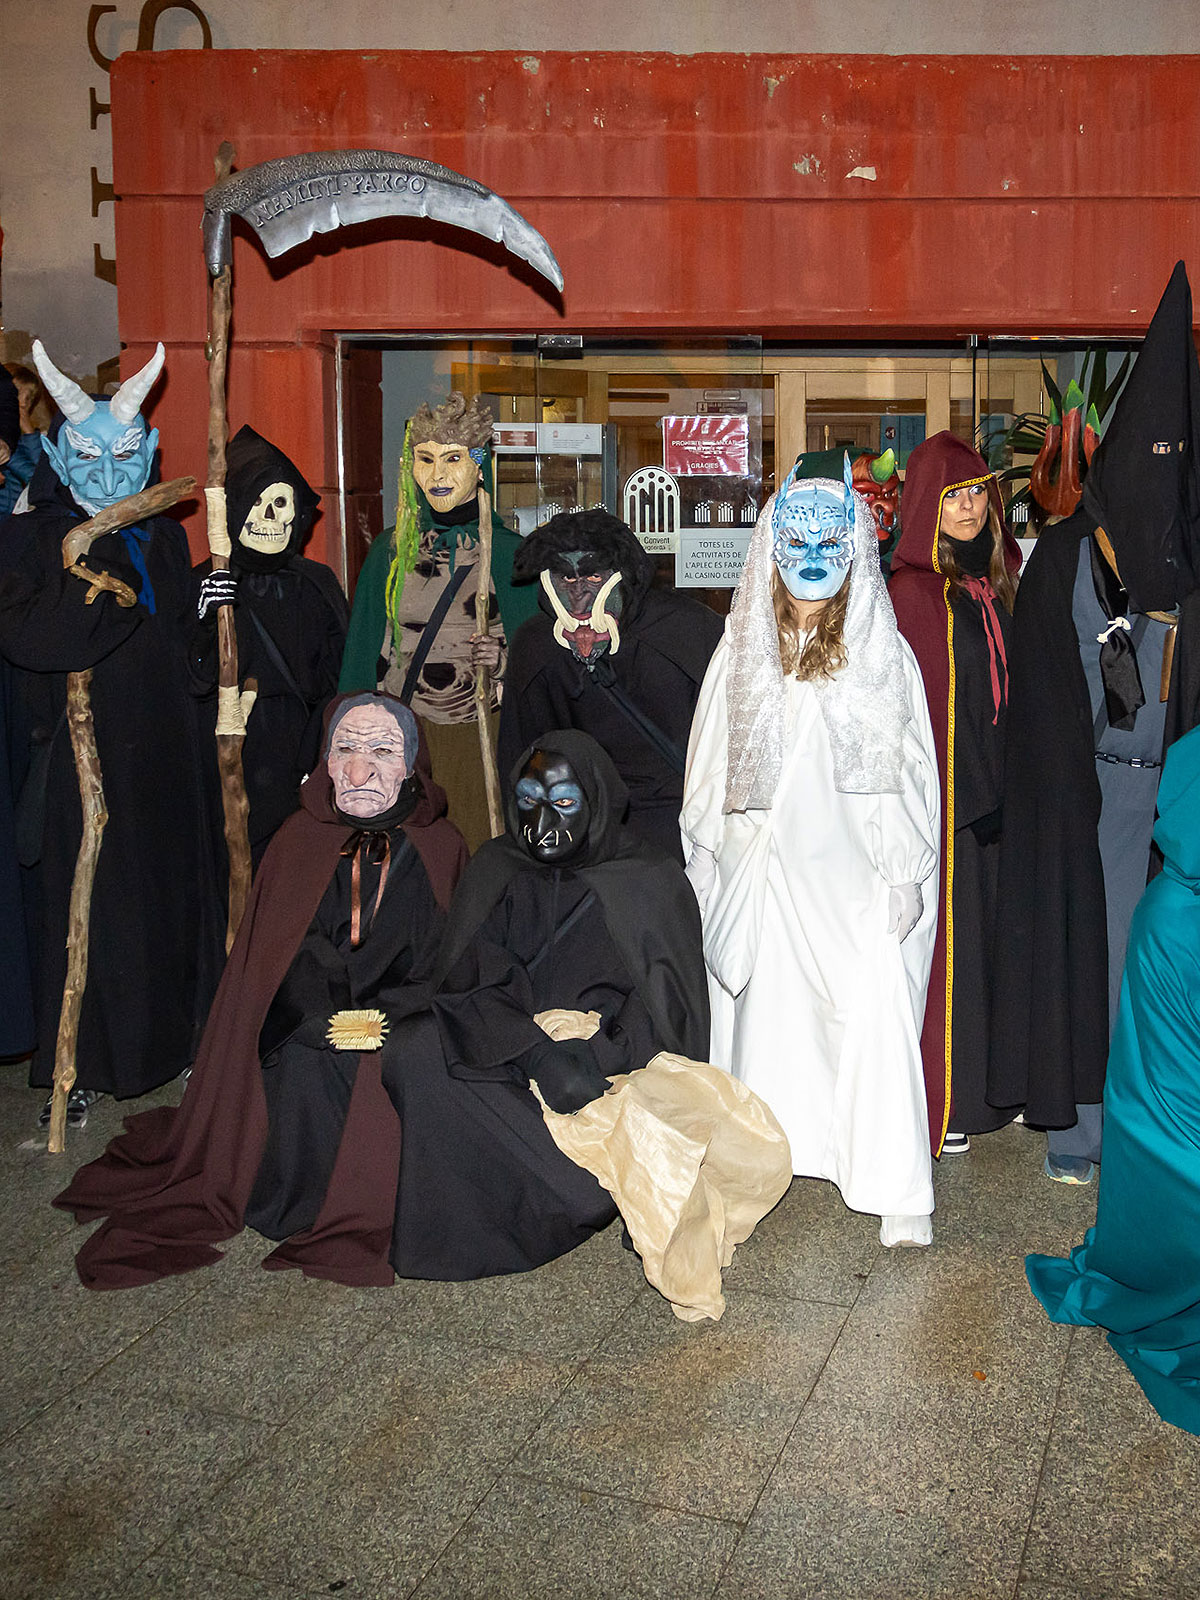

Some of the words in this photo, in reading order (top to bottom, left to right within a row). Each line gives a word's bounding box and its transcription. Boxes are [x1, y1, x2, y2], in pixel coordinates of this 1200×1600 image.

[350, 172, 427, 195] PARCO
[643, 536, 670, 545] Convent
[699, 541, 721, 549] TOTES
[722, 541, 735, 549] LES
[691, 551, 731, 559] ACTIVITATS
[732, 551, 742, 559] DE
[685, 561, 713, 569] L'APLEC
[714, 561, 723, 569] ES
[694, 571, 721, 579] CASINO
